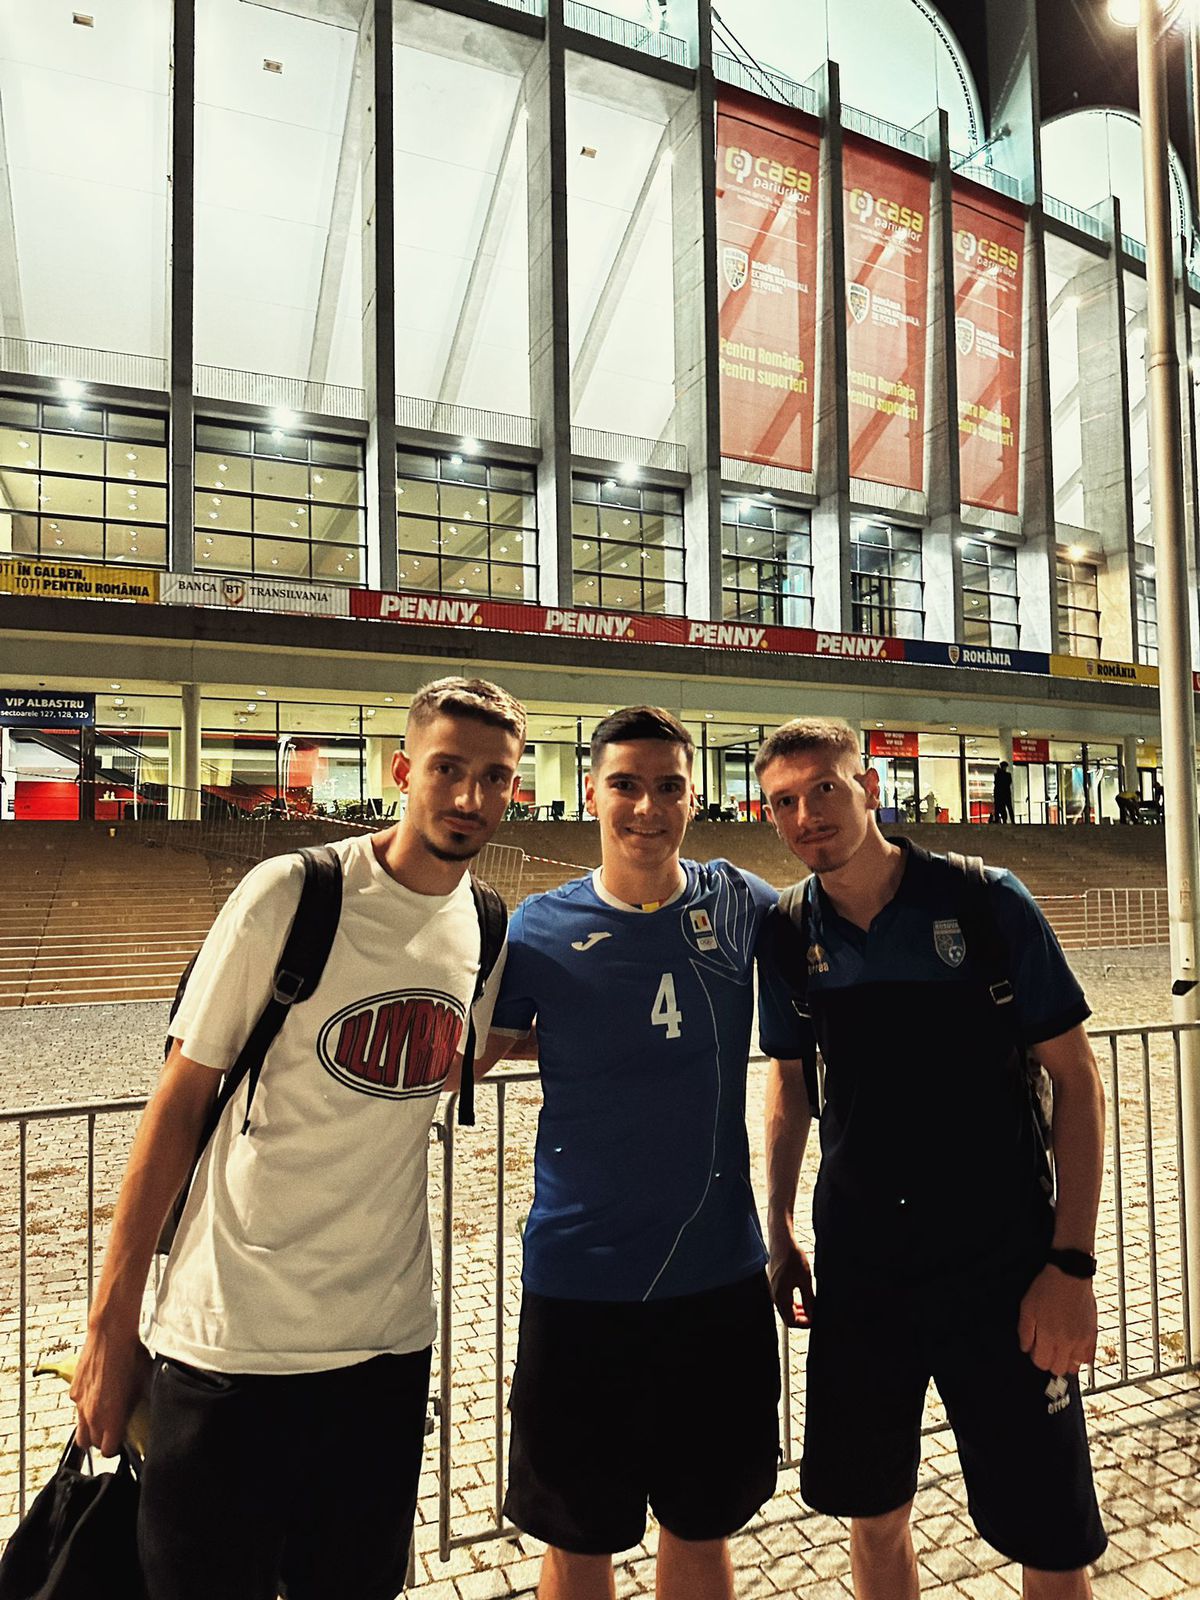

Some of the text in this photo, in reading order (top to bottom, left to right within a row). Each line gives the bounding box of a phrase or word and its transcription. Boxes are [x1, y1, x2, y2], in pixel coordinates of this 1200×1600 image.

[754, 157, 812, 193] casa
[753, 177, 810, 203] pariurilor
[876, 198, 924, 233] casa
[874, 217, 921, 242] pariulor
[978, 238, 1019, 270] casa
[848, 371, 876, 390] entru
[848, 390, 876, 410] entru
[17, 562, 31, 576] ÎN
[34, 566, 87, 581] GALBEN,
[43, 580, 92, 593] PENTRU
[95, 583, 150, 597] ROMÂNIA
[178, 580, 217, 593] BANCA
[226, 585, 241, 594] BT
[962, 649, 1012, 667] ROMÂNIA
[1097, 662, 1137, 679] ROMÂNIA
[5, 697, 84, 709] VIP ALBASTRU
[58, 711, 73, 719] 128,
[75, 711, 89, 719] 129
[651, 972, 682, 1039] 4
